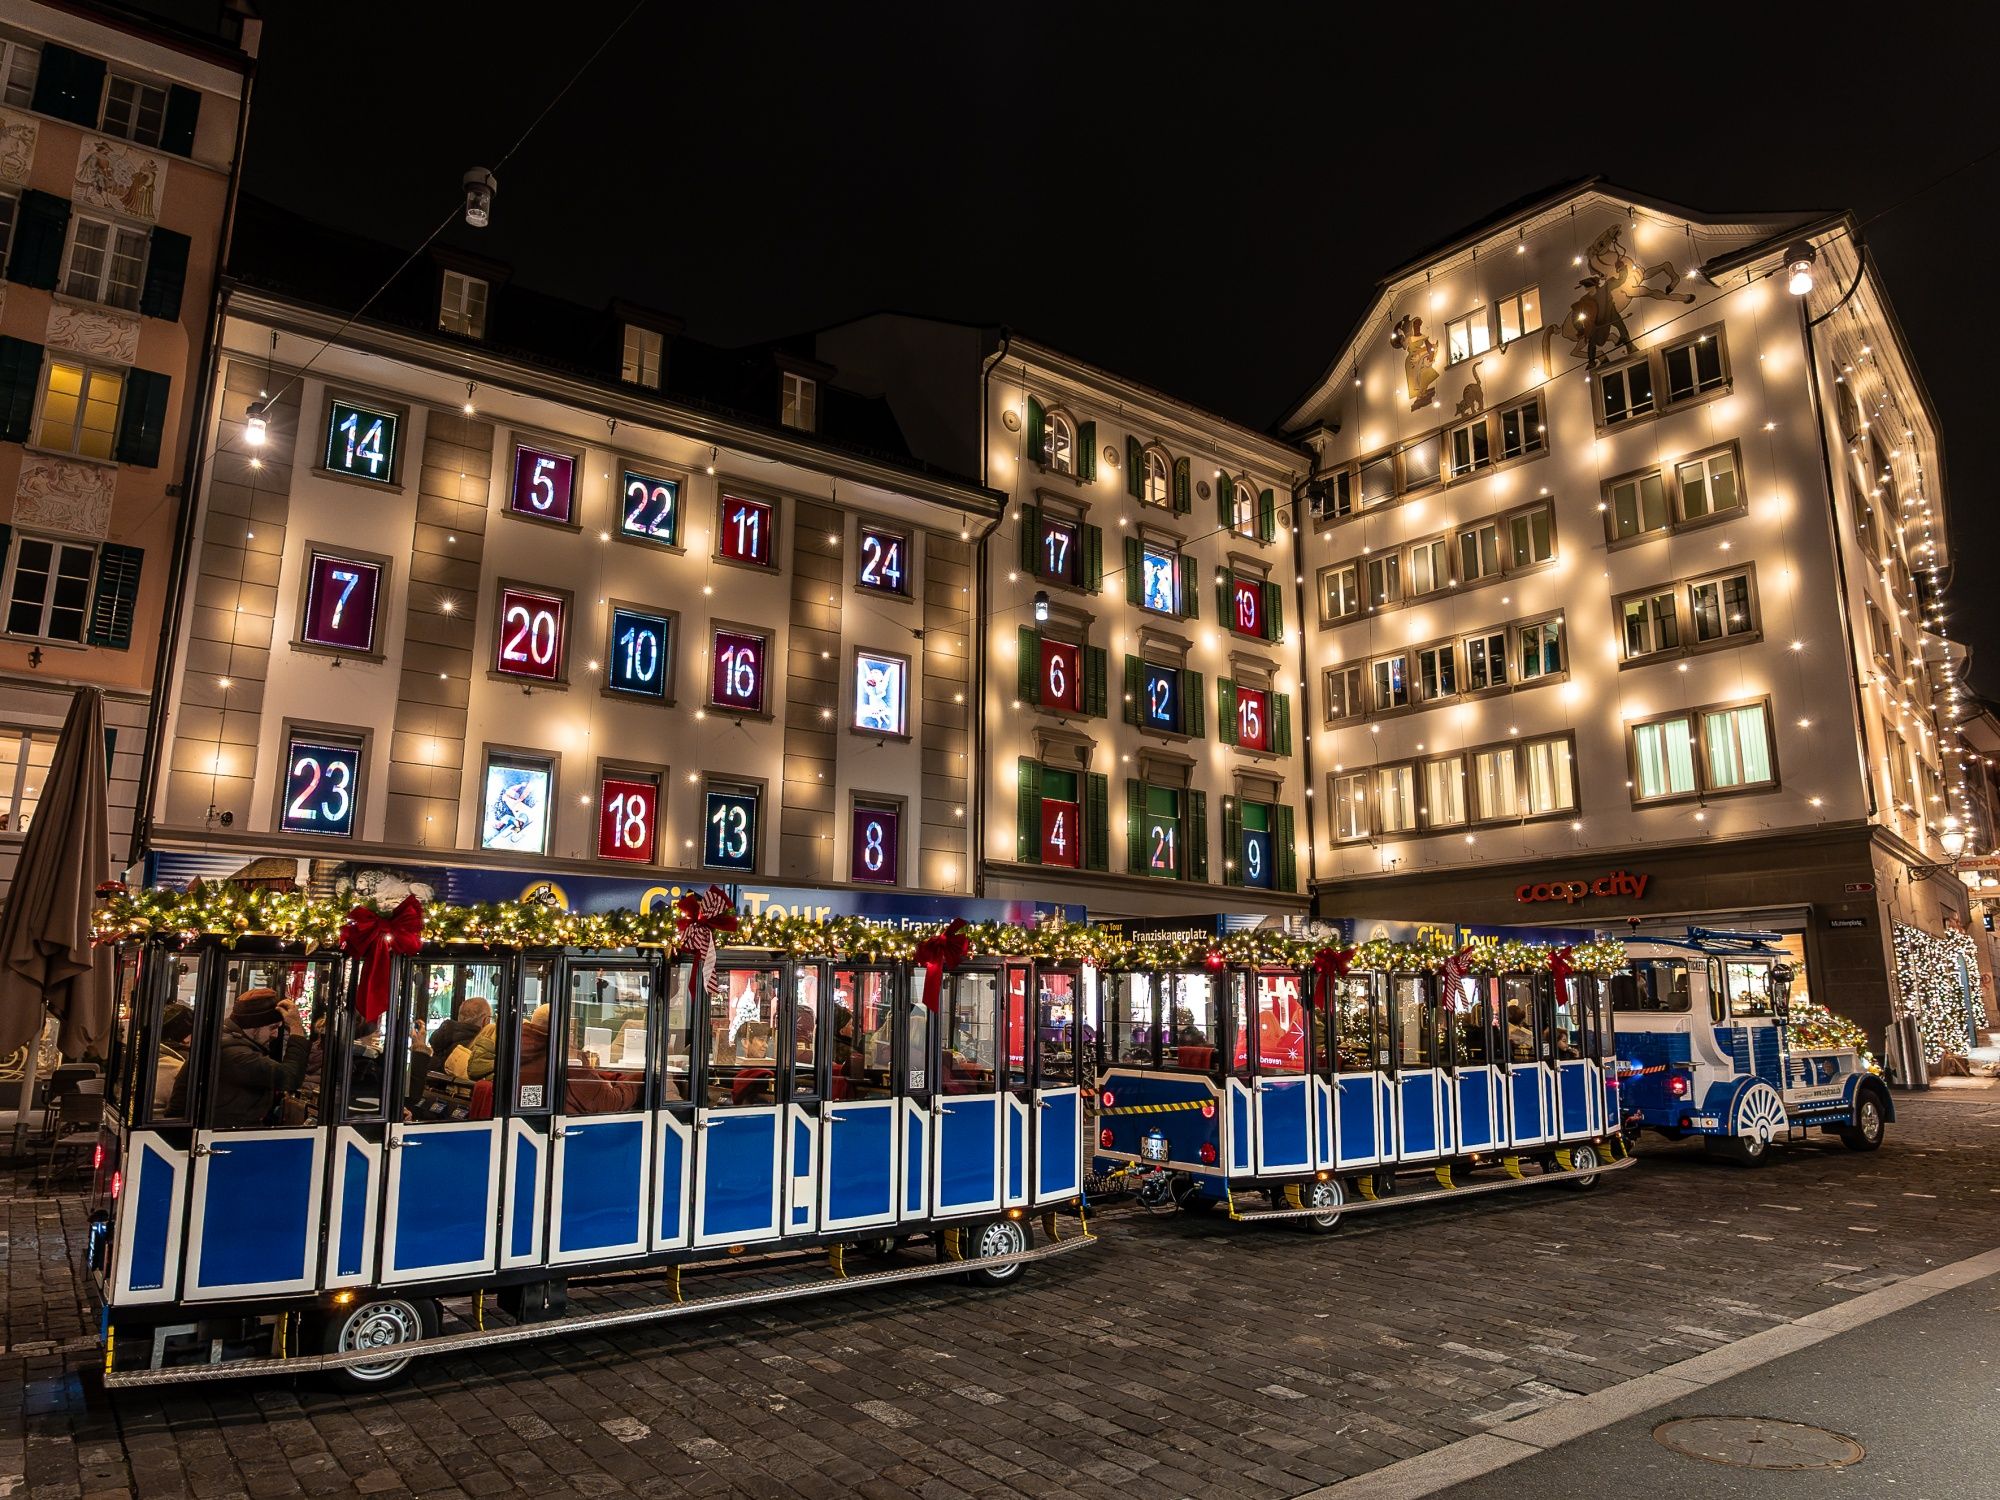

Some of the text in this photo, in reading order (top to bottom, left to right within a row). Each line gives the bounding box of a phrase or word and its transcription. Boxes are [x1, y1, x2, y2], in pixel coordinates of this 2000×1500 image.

[340, 413, 384, 474] 14
[531, 457, 556, 510] 5
[624, 480, 672, 539] 22
[732, 507, 759, 558] 11
[861, 536, 901, 588] 24
[1045, 530, 1068, 575] 17
[331, 570, 359, 629] 7
[1236, 588, 1255, 628] 19
[504, 606, 557, 665] 20
[620, 627, 658, 683] 10
[720, 645, 755, 699] 16
[1049, 654, 1065, 698] 6
[1147, 677, 1170, 721] 12
[1238, 698, 1260, 739] 15
[287, 757, 350, 822] 23
[608, 792, 647, 849] 18
[712, 804, 748, 858] 13
[1050, 811, 1066, 857] 4
[864, 821, 884, 872] 8
[1151, 825, 1175, 870] 21
[1247, 839, 1261, 879] 9
[744, 893, 831, 928] Tour
[1515, 870, 1648, 904] coop city
[1110, 922, 1122, 931] Tour
[1132, 927, 1207, 944] Franziskanerplatz
[1417, 926, 1499, 948] City Tour
